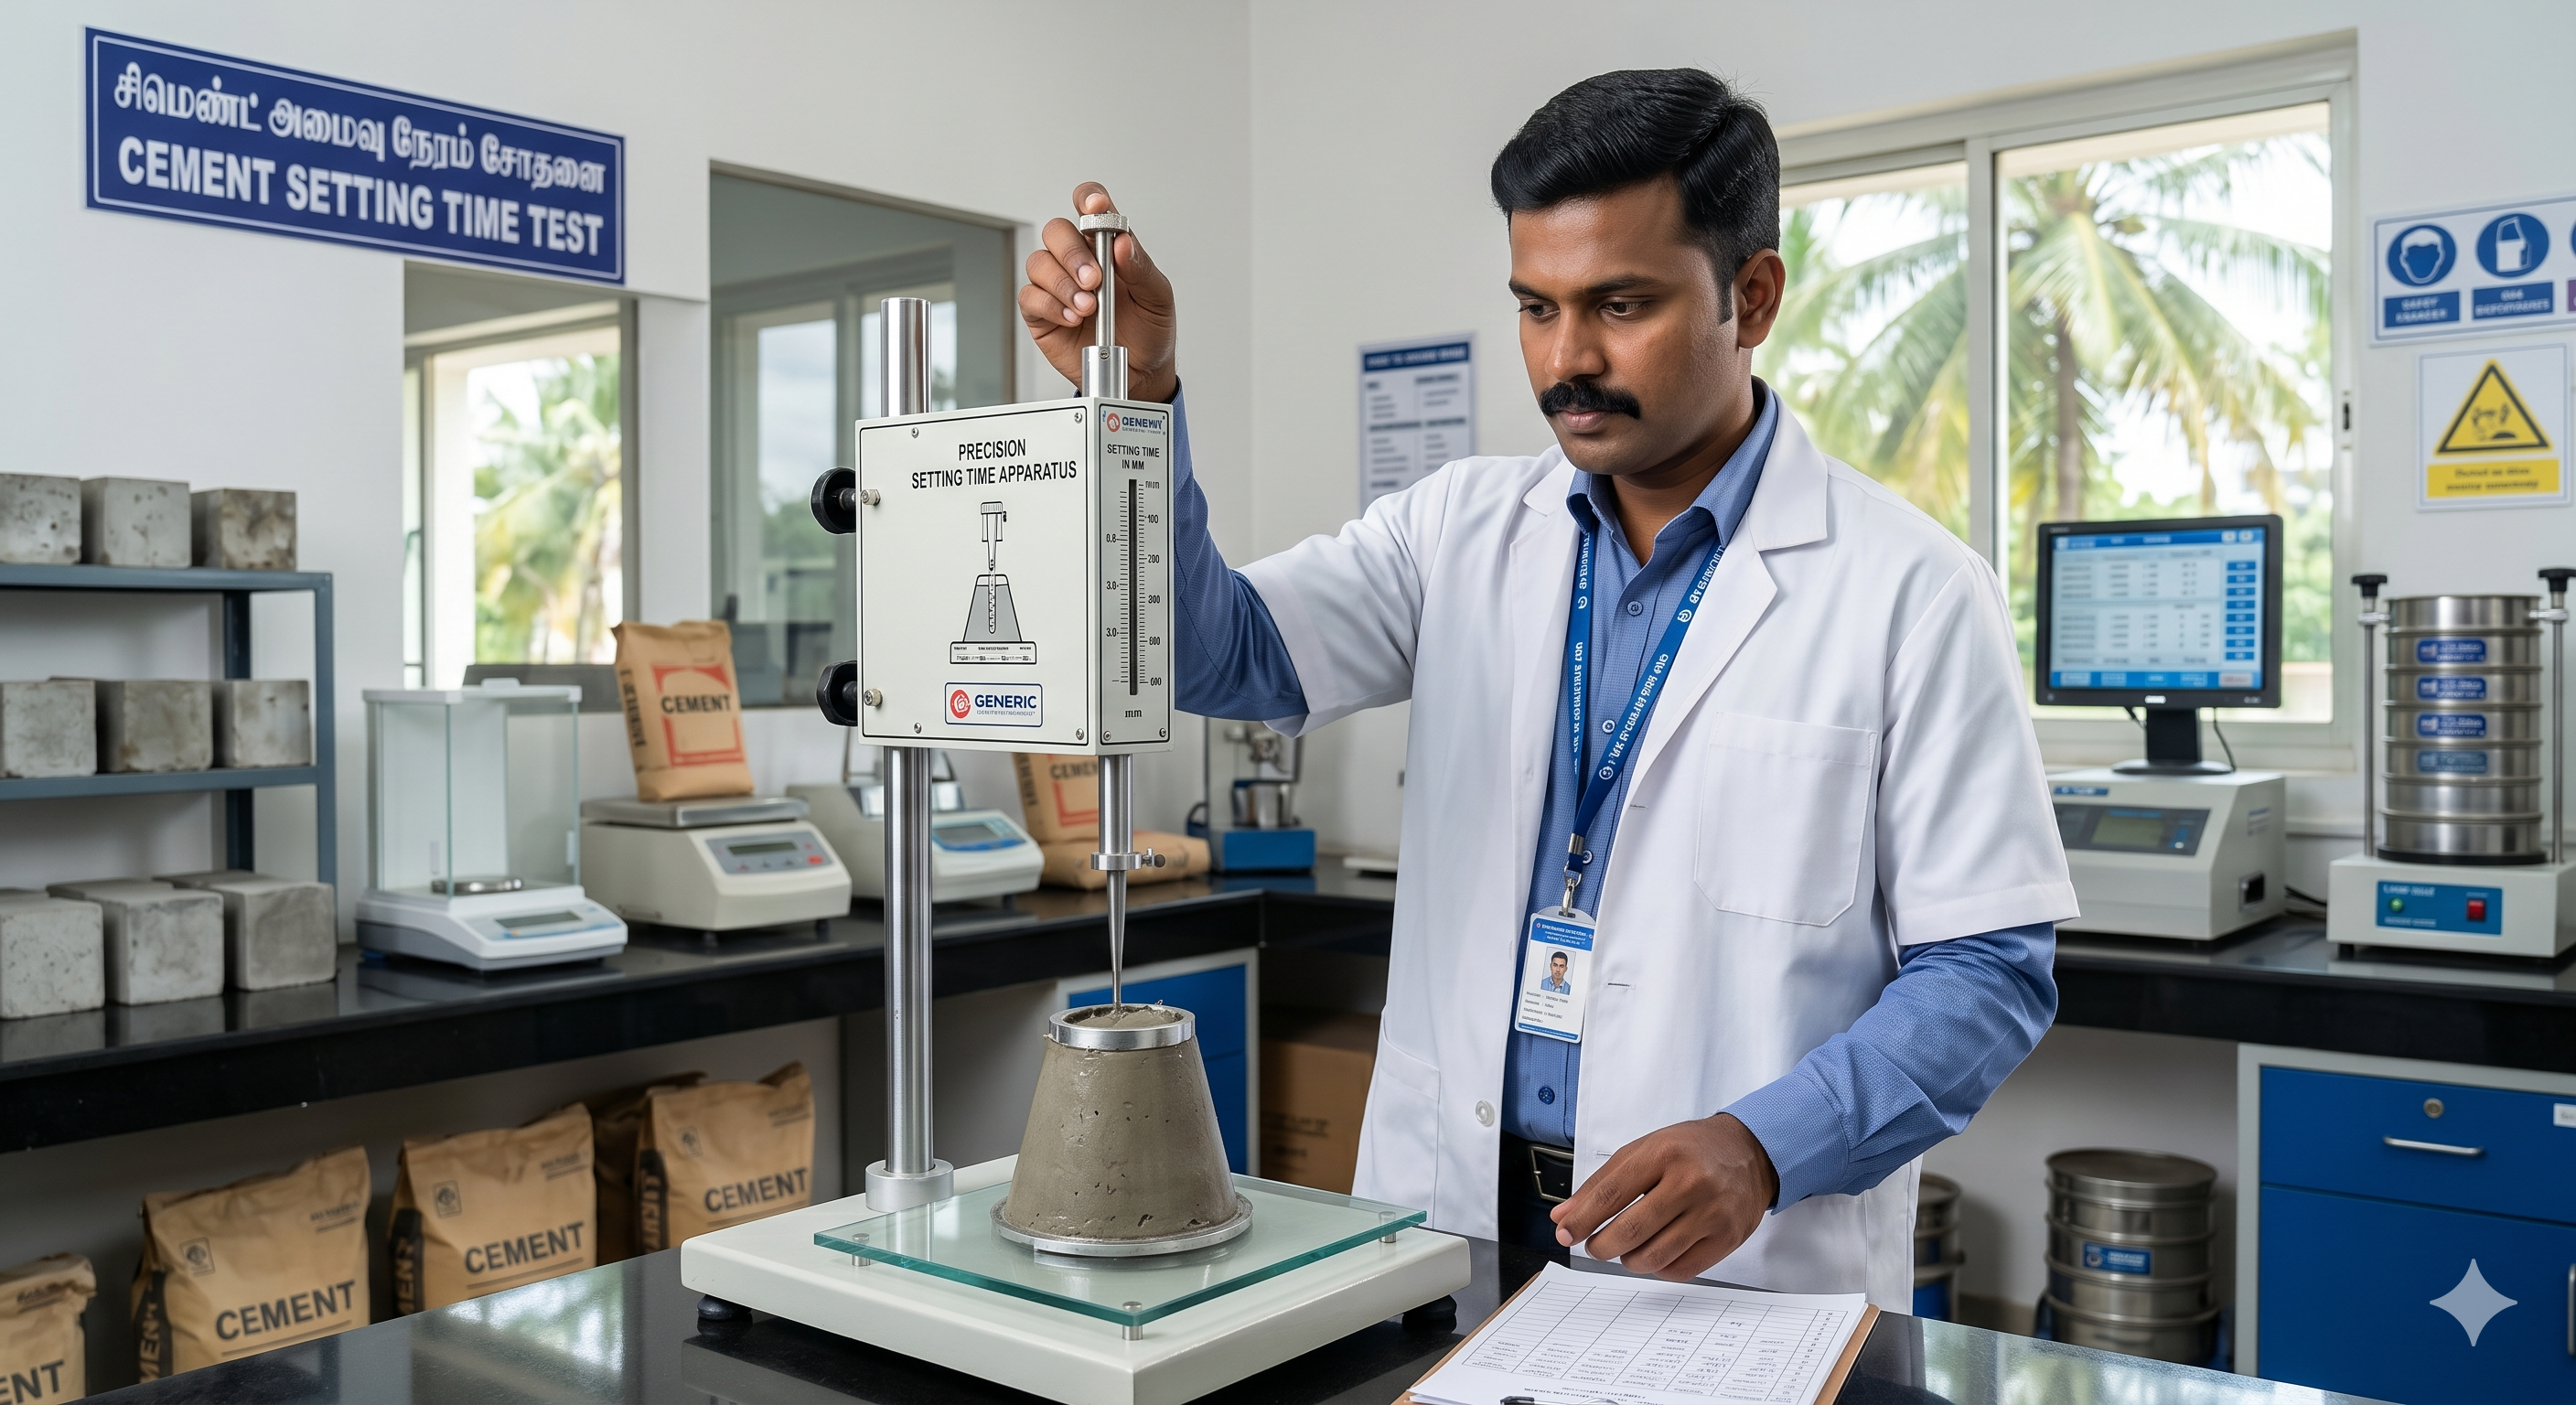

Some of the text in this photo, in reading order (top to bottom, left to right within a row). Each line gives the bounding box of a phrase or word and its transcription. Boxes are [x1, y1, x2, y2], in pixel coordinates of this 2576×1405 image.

[113, 61, 606, 194] சிமெண்ட் அமைவு நேரம் சோதனை
[118, 135, 604, 256] CEMENT SETTING TIME TEST
[959, 438, 1026, 461] PRECISION
[1107, 444, 1160, 458] SETTING TIME
[911, 460, 1078, 489] SETTING TIME APPARATUS
[1122, 459, 1144, 470] IN MM
[1147, 514, 1159, 523] 100
[660, 694, 731, 714] CEMENT
[974, 694, 1037, 709] GENERIC
[1124, 710, 1143, 718] mm
[704, 1166, 809, 1214] CEMENT
[465, 1221, 585, 1275] CEMENT
[215, 1279, 356, 1342] CEMENT
